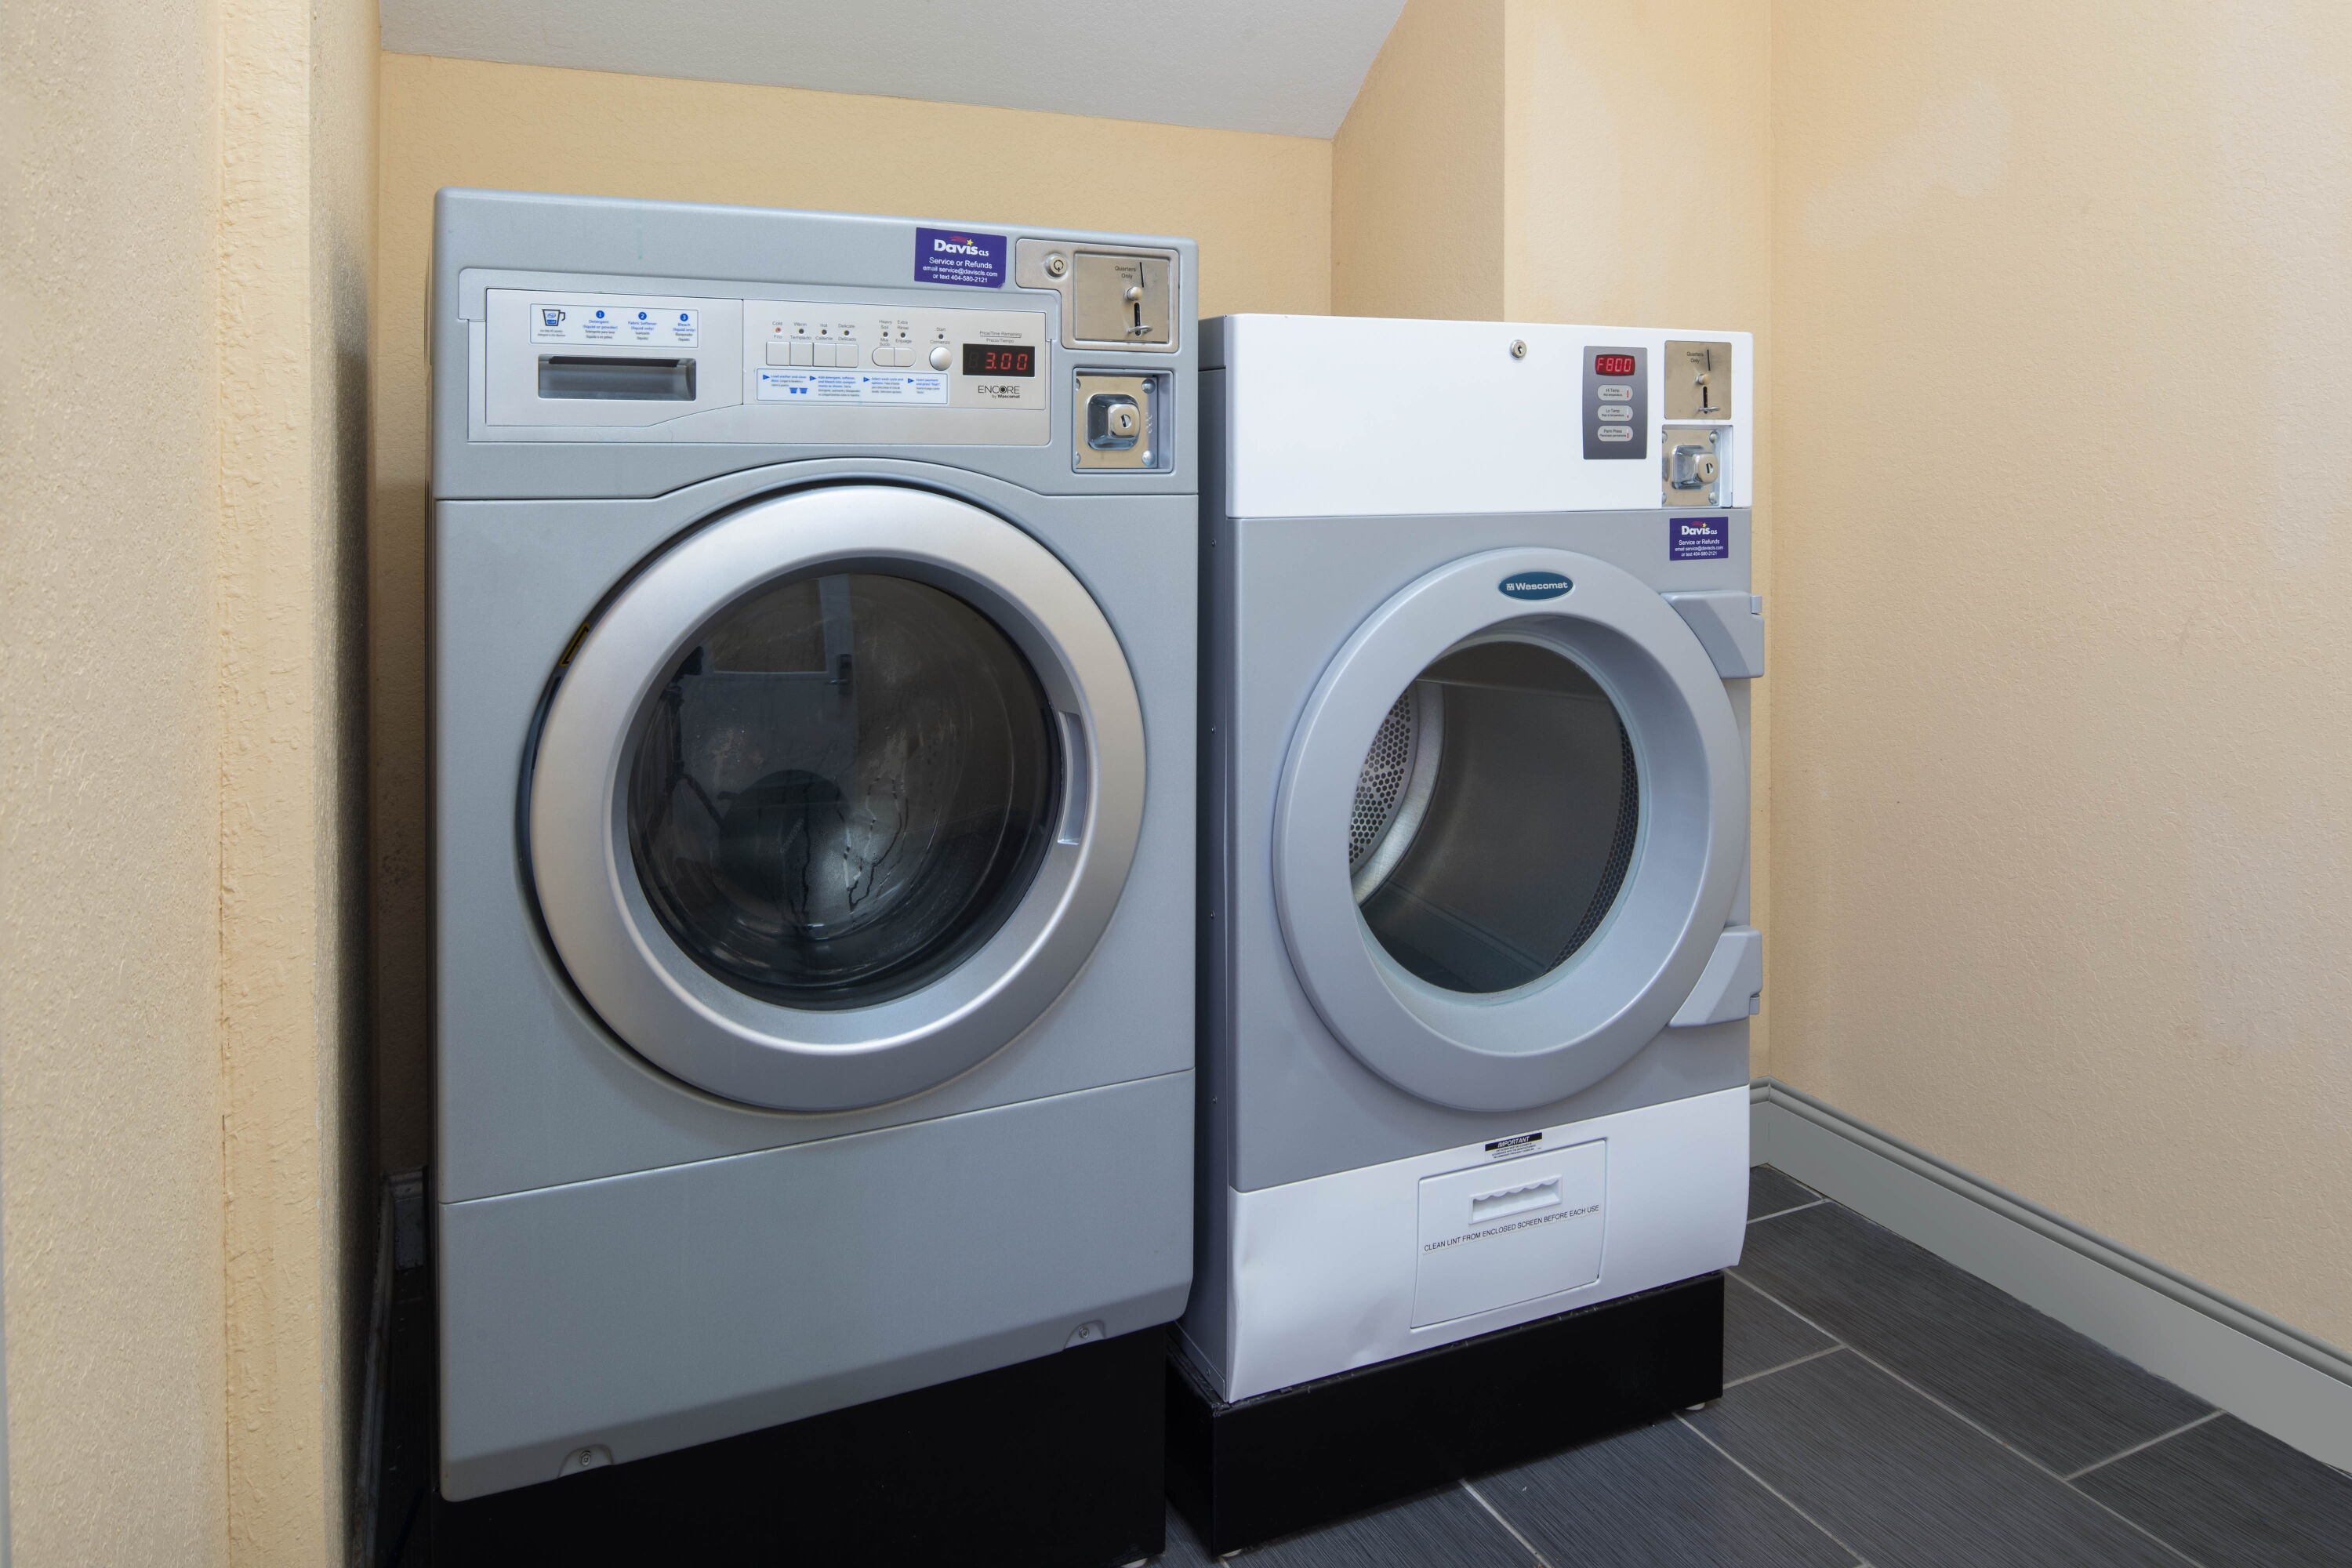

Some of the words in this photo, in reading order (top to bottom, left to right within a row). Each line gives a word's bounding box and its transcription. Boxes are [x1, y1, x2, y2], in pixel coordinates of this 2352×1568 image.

[934, 239, 978, 256] Davis
[929, 256, 954, 266] Service
[964, 260, 993, 269] Refunds
[938, 267, 998, 277] service@daviscls.com
[985, 352, 1028, 370] 3.00
[1596, 358, 1632, 372] F800
[978, 385, 1020, 394] ENCORE
[1681, 525, 1710, 535] Davis
[1515, 582, 1568, 590] Wascomat
[1497, 1136, 1530, 1148] IMPORTANT
[1424, 1240, 1446, 1252] CLEAN
[1446, 1236, 1461, 1246] LINT
[1462, 1232, 1481, 1243] FROM
[1482, 1224, 1516, 1237] ENCLOSED
[1517, 1218, 1543, 1229] SCREEN
[1544, 1211, 1568, 1223] BEFORE
[1569, 1207, 1586, 1217] EACH
[1587, 1204, 1599, 1213] USE
